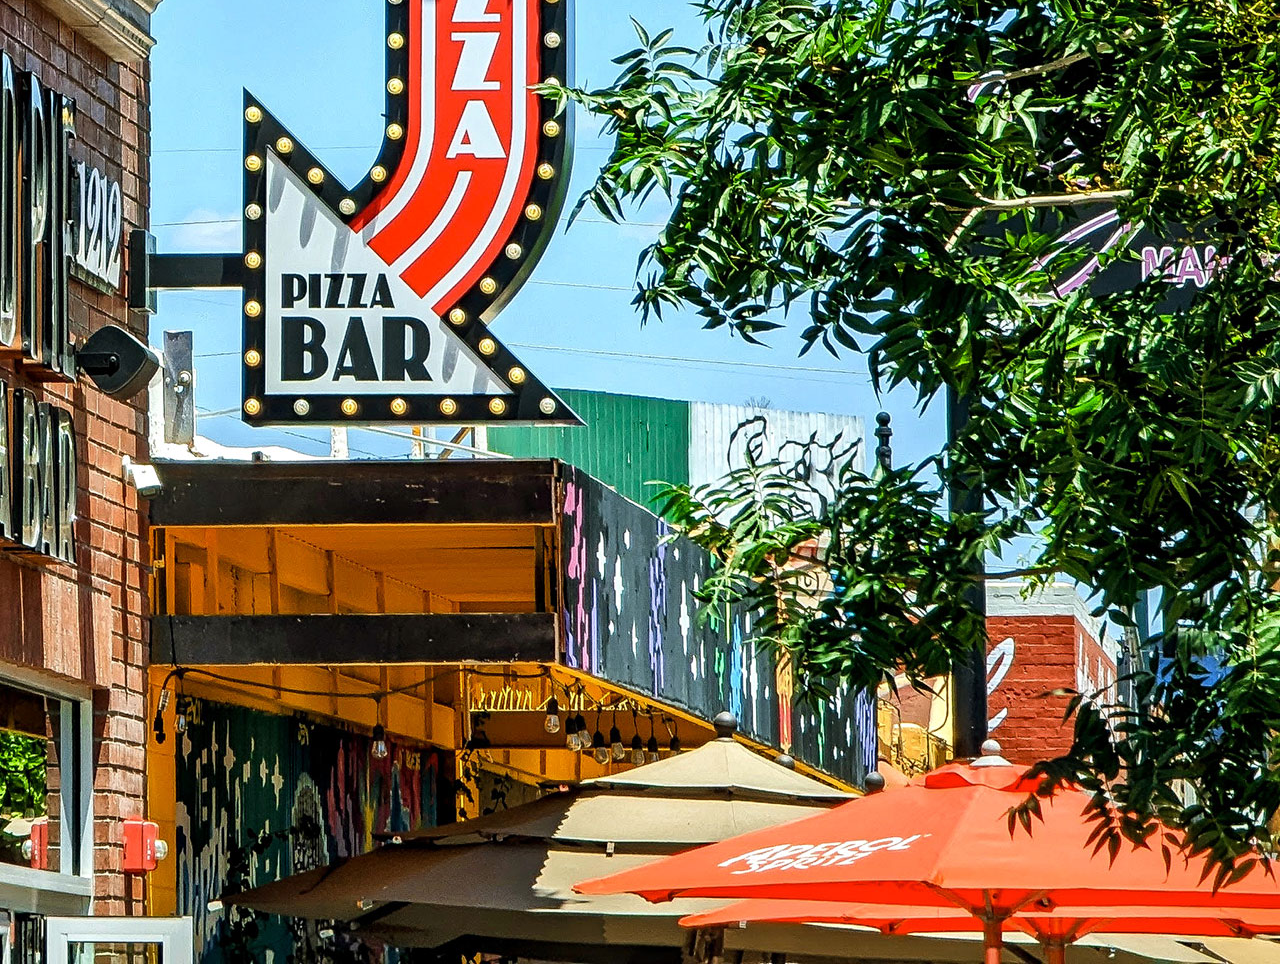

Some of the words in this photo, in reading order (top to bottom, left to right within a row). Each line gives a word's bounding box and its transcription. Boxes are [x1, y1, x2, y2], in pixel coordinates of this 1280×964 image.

[76, 161, 120, 289] 1212
[281, 273, 394, 309] PIZZA
[281, 316, 431, 382] BAR
[718, 834, 921, 867] APEROL
